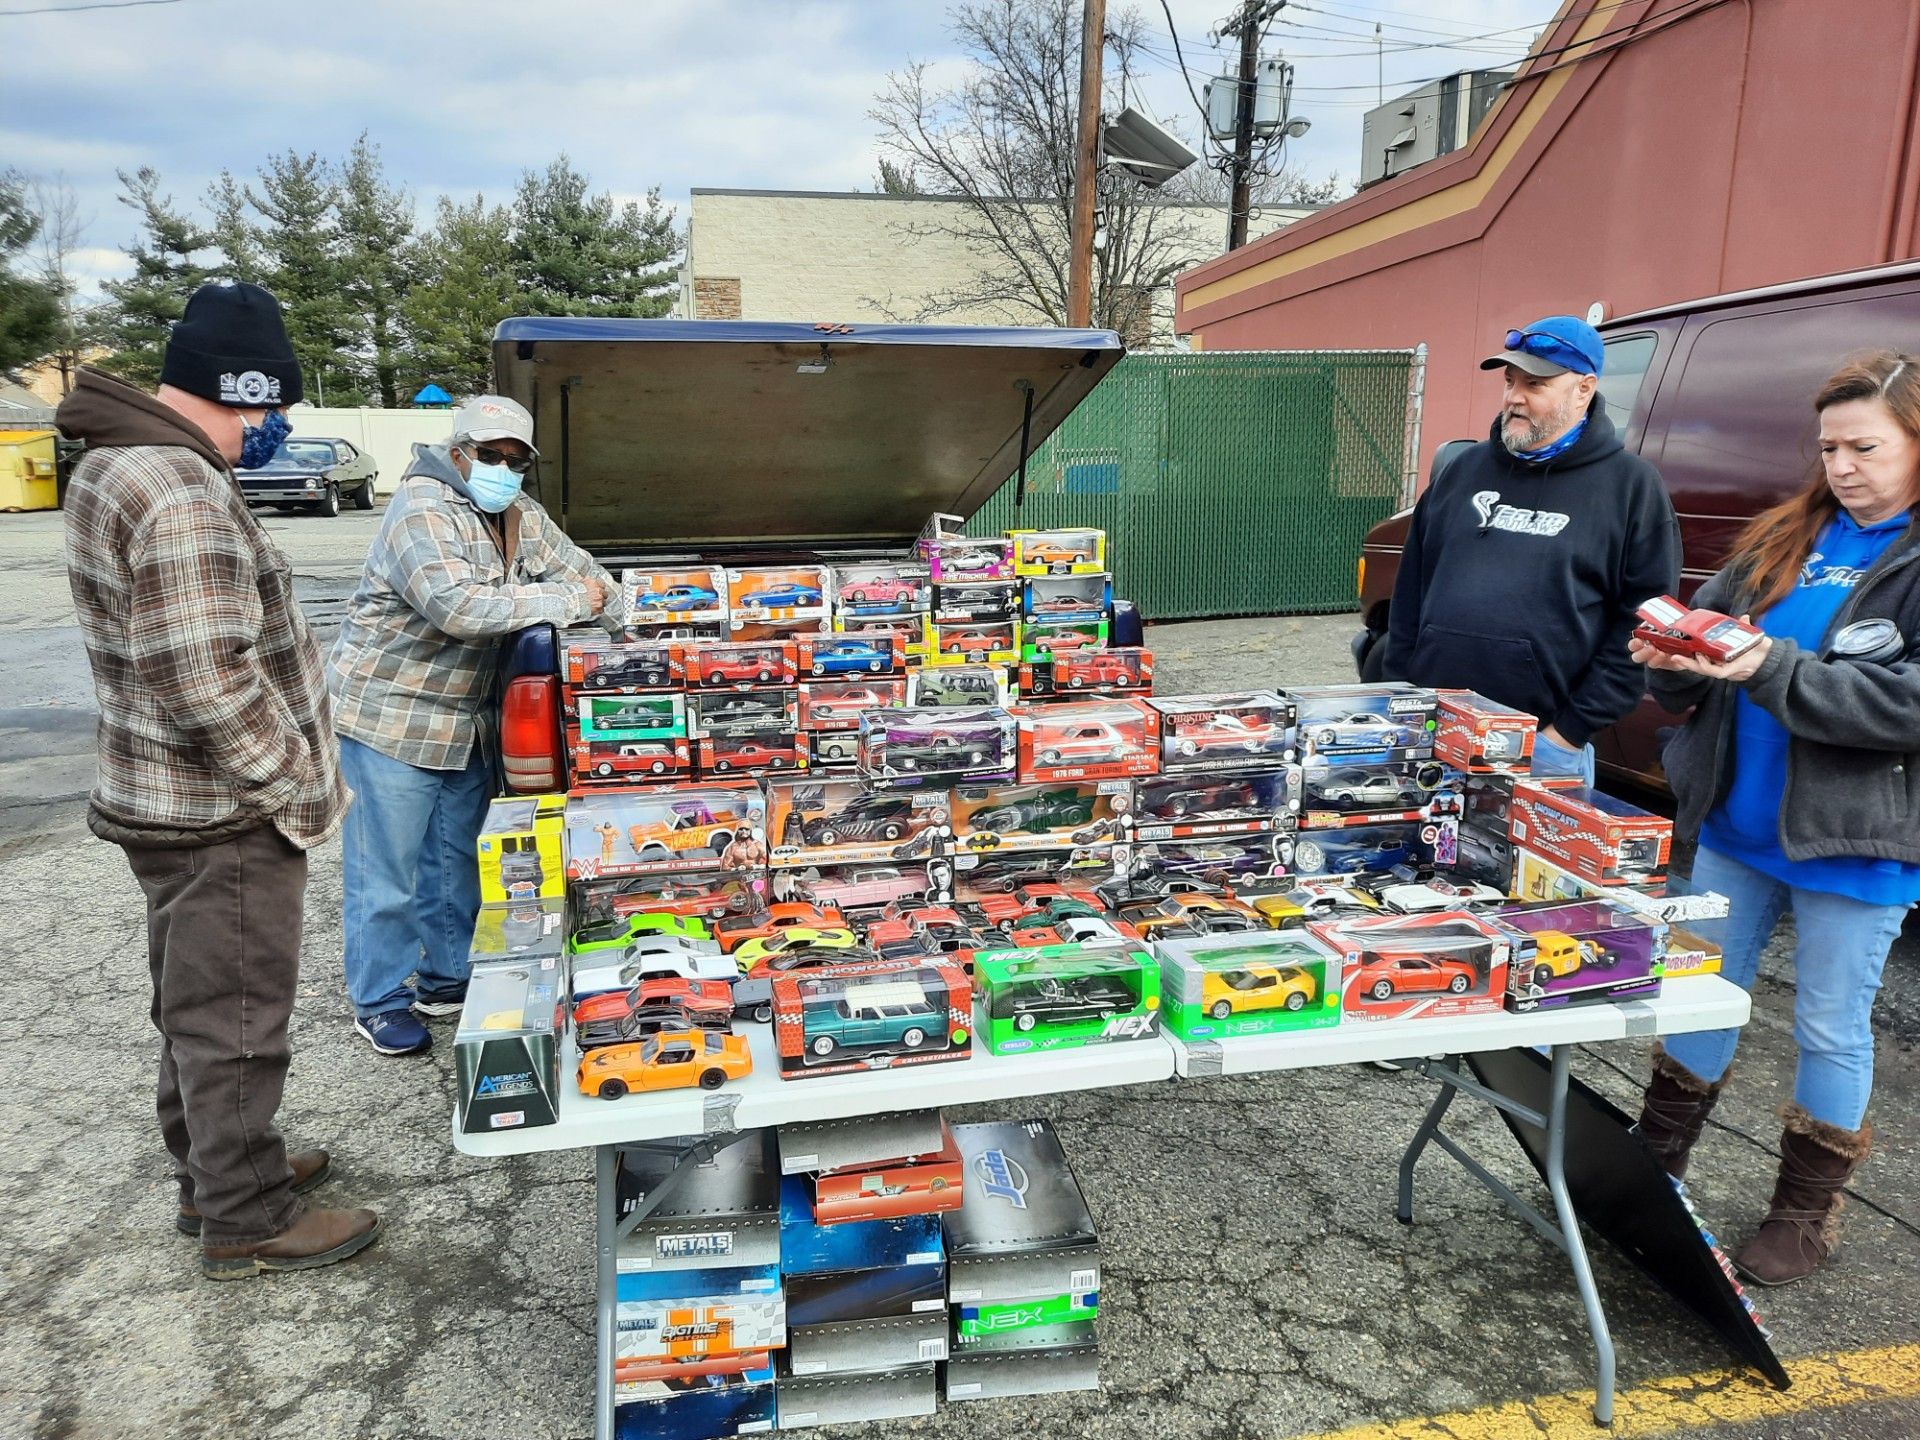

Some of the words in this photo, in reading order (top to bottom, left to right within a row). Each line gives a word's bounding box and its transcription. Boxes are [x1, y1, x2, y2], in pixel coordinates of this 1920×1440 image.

[959, 572, 990, 580] MACHINE
[1166, 711, 1217, 726] CHRISTINE
[1068, 768, 1084, 777] FORD
[1100, 783, 1129, 791] METALS
[986, 948, 1042, 962] NEX
[1518, 1000, 1540, 1010] Maisto
[1101, 1010, 1159, 1039] NEX
[1225, 1018, 1275, 1035] NEX
[495, 1080, 534, 1091] LEGENDS
[984, 1149, 1028, 1210] Jada
[662, 1236, 728, 1252] METALS
[619, 1319, 656, 1328] METALS
[969, 1306, 1043, 1332] NEX
[662, 1322, 719, 1337] BIGTIME
[660, 1333, 718, 1343] KUSTOMS
